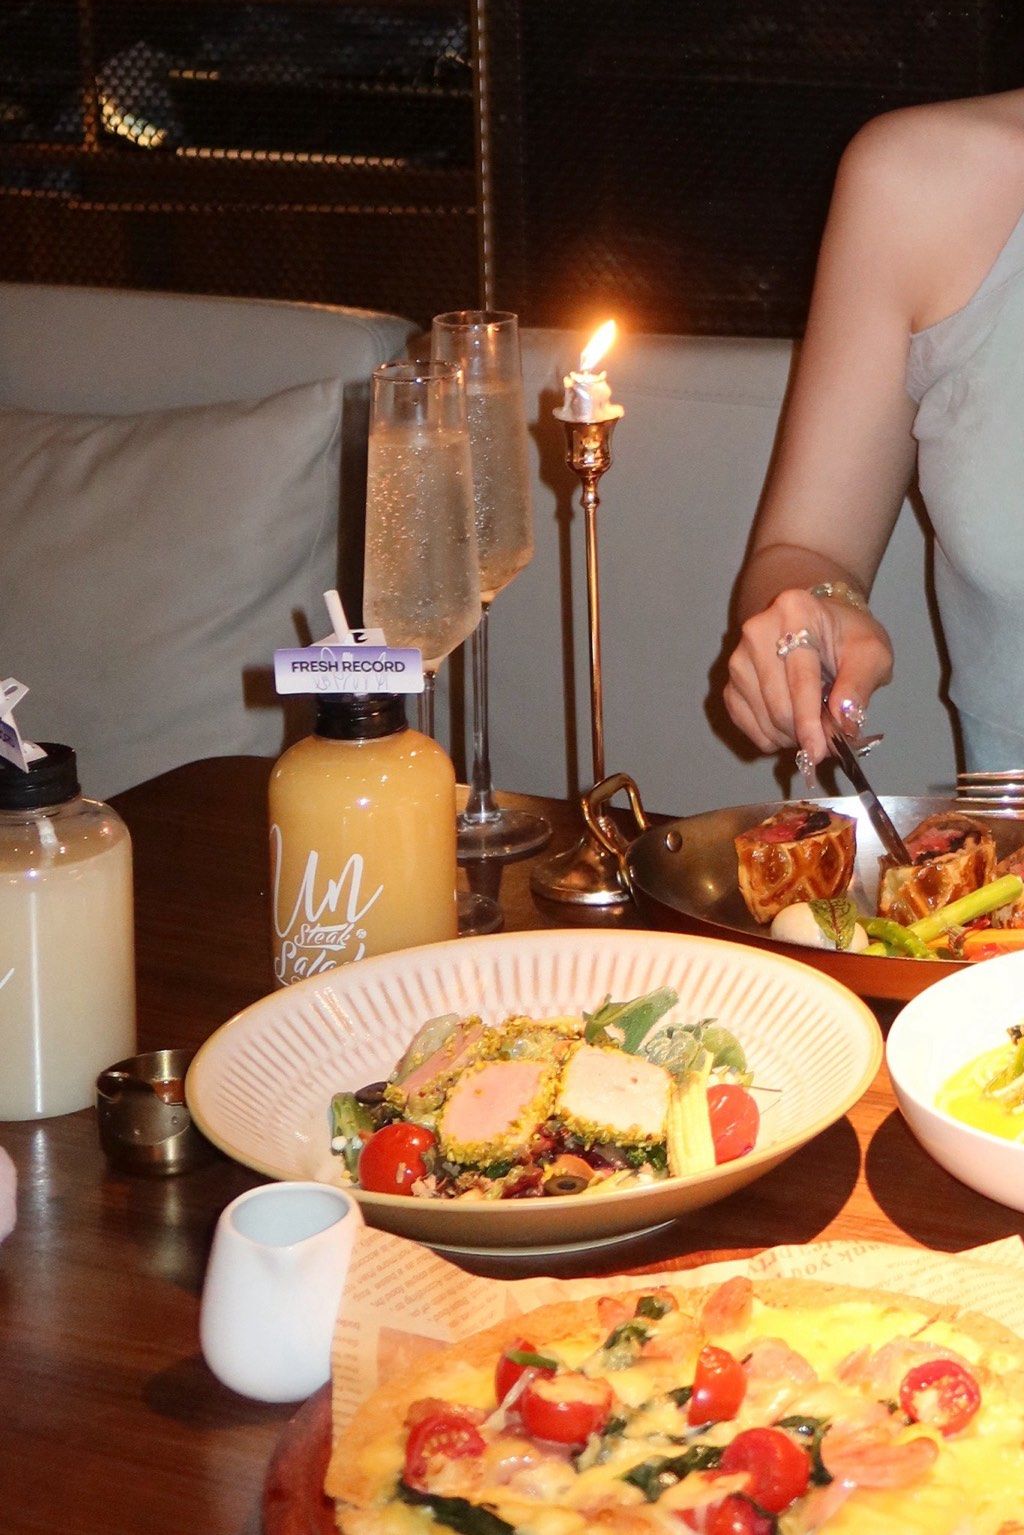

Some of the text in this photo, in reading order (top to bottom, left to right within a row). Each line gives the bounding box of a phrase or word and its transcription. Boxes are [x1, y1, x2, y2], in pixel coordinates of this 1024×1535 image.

[291, 660, 406, 673] FRESH RECORD
[274, 938, 366, 985] Sala
